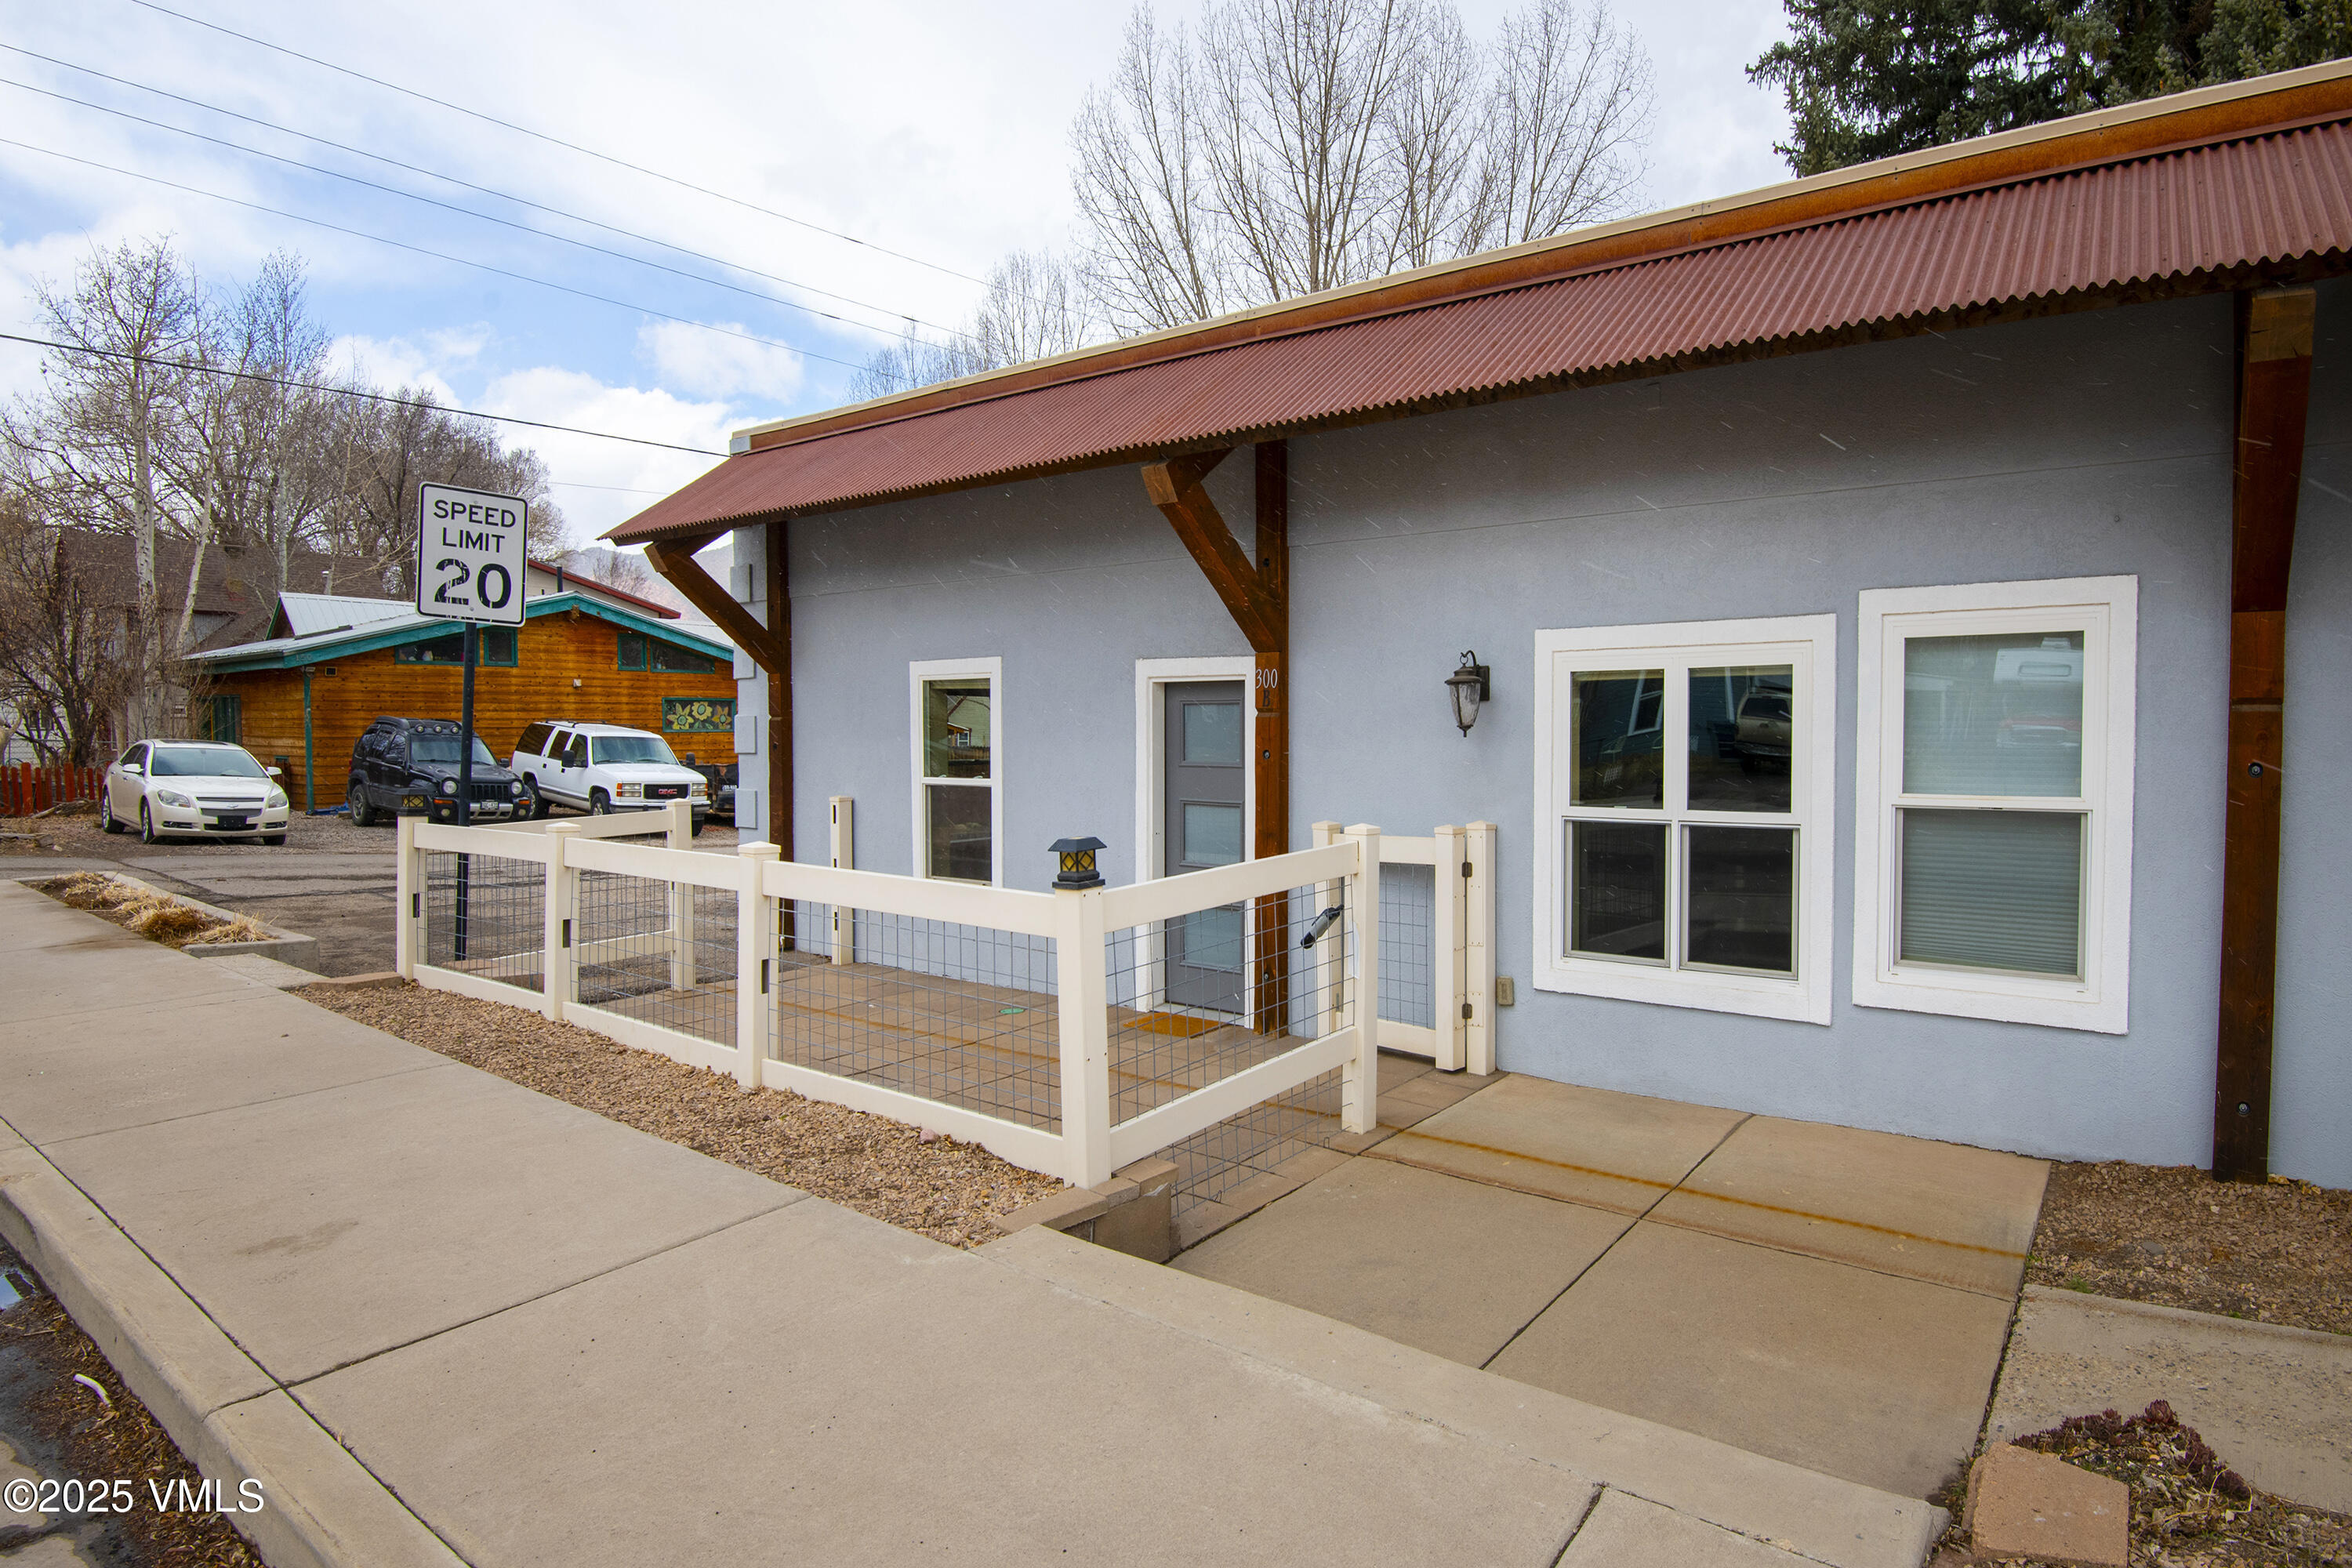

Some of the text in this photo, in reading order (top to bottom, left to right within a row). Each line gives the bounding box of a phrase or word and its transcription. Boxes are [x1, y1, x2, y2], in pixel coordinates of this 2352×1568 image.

[434, 499, 516, 528] SPEED
[442, 527, 505, 553] LIMIT
[434, 558, 512, 609] 20
[1256, 669, 1278, 688] 300
